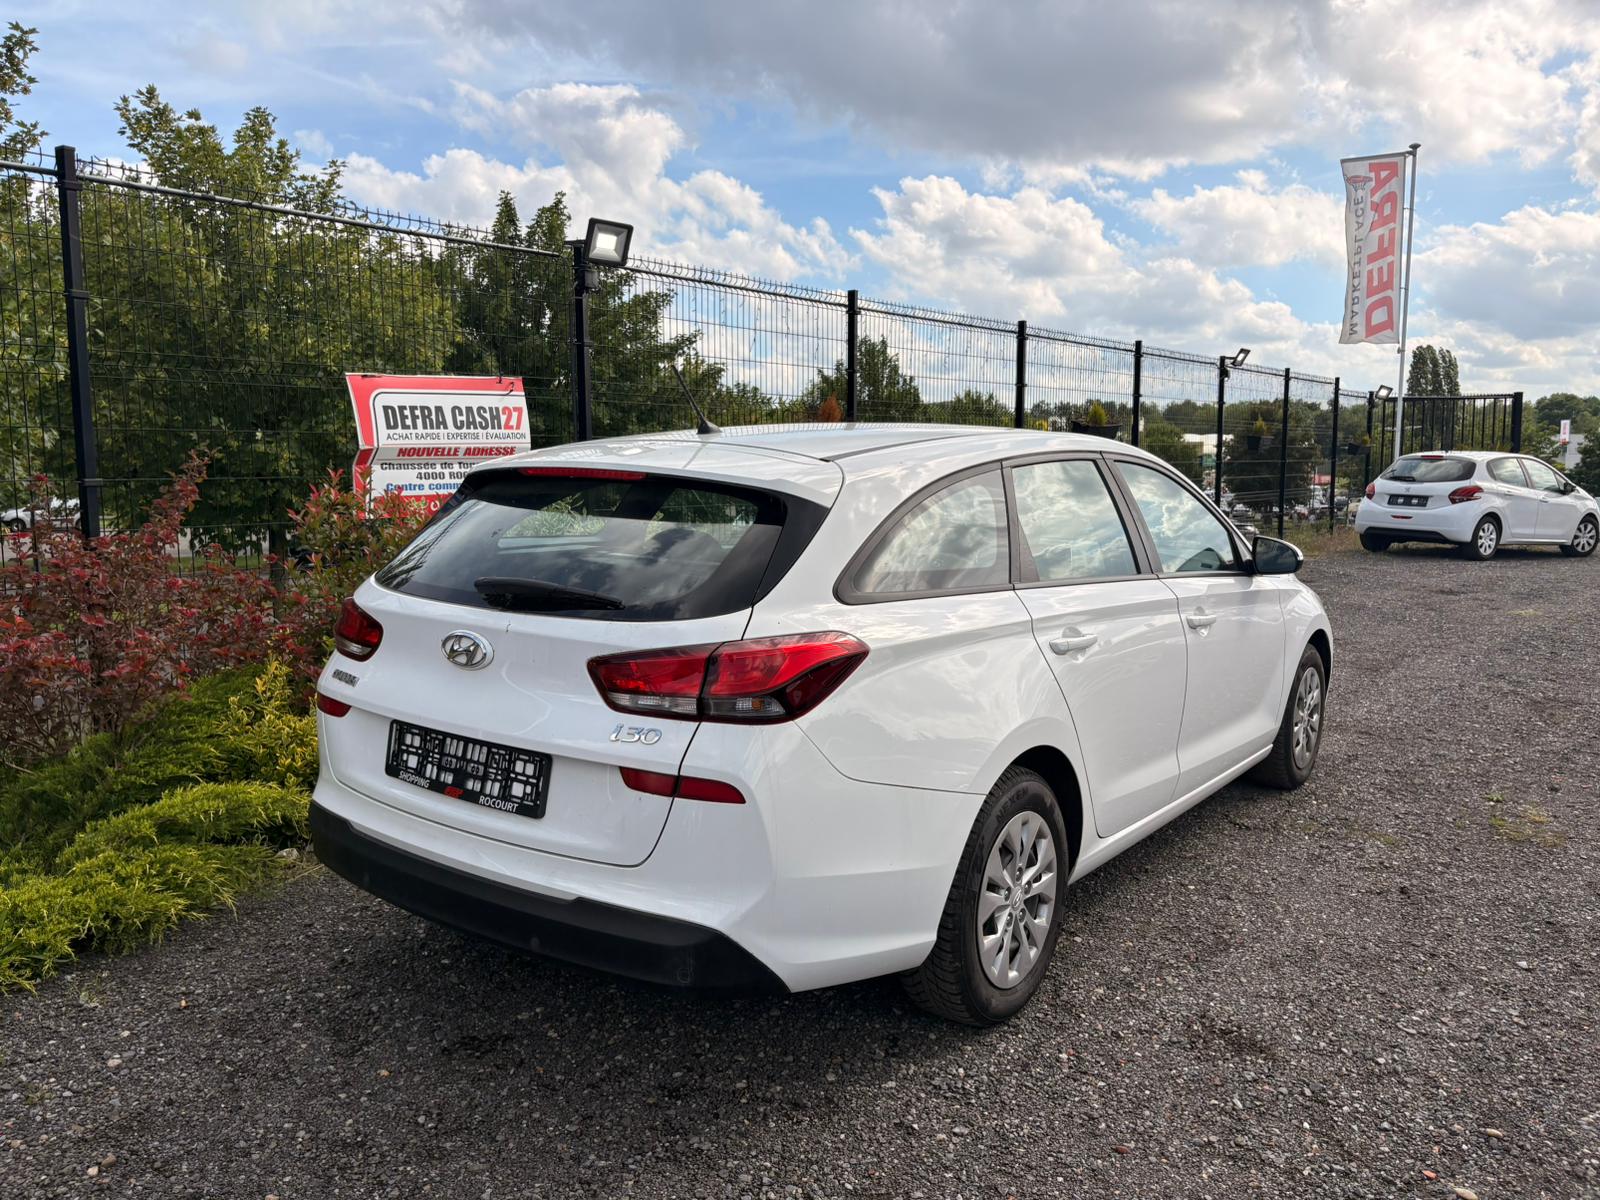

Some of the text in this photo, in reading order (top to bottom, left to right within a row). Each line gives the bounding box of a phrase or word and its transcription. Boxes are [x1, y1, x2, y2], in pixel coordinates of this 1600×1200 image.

[382, 405, 524, 430] DEFRA CASH27
[386, 431, 526, 441] ACHAT RAPIDE EXPERTISE ÉVALUATION
[397, 446, 517, 457] NOUVELLE ADRESSE
[380, 462, 437, 470] Chaussée
[440, 462, 453, 470] de
[416, 471, 445, 480] 4000
[428, 482, 461, 490] comm
[608, 722, 663, 746] i30
[399, 770, 519, 813] SHOPPING ROCOURT
